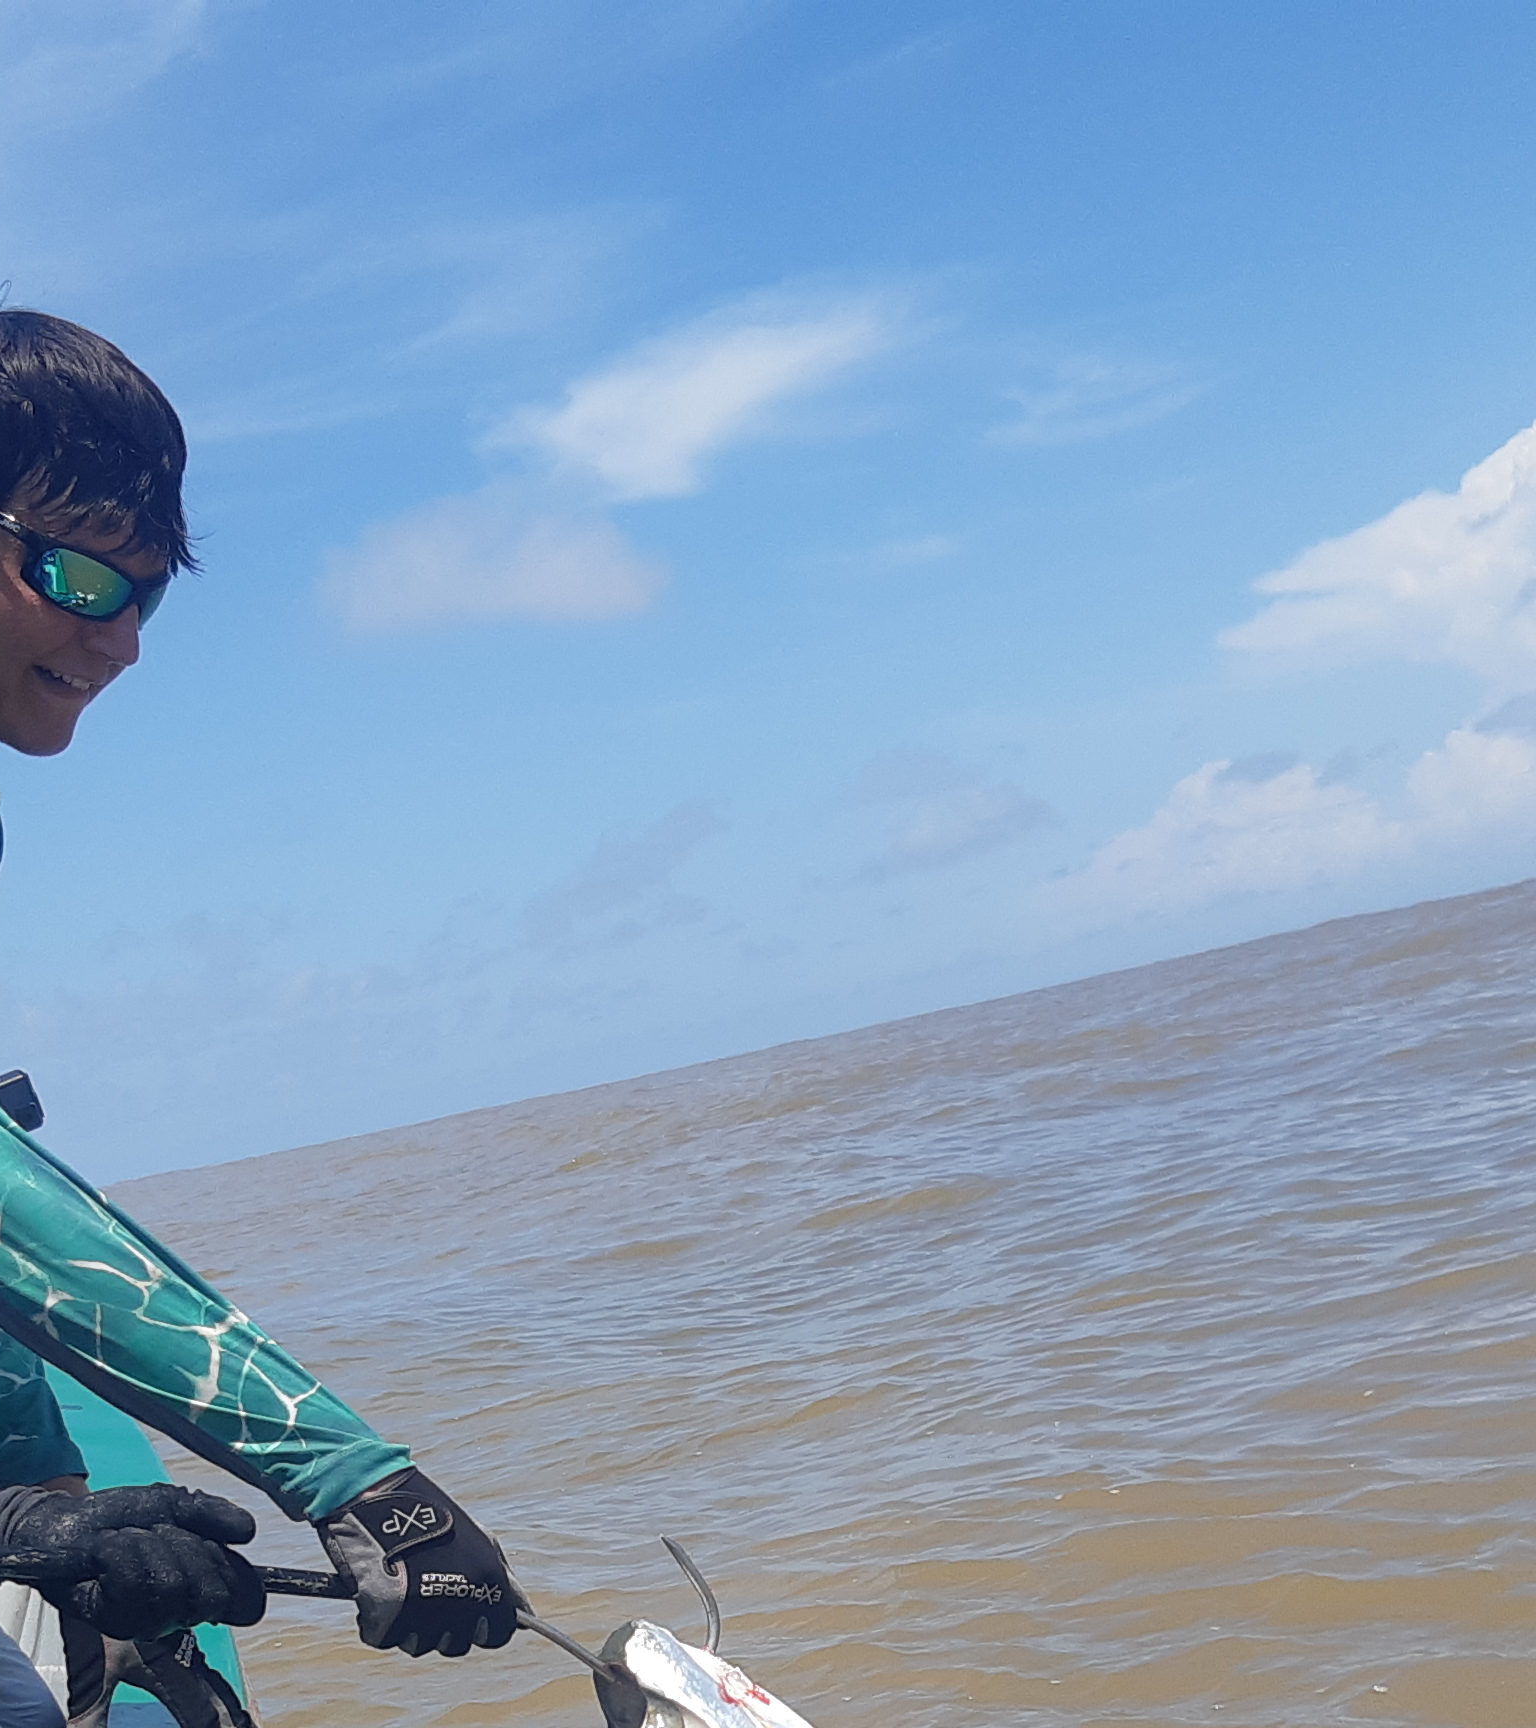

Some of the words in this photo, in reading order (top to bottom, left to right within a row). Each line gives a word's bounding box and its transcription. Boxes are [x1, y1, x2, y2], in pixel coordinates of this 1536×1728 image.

[382, 1503, 437, 1537] EXP
[421, 1573, 468, 1584] TACKLES
[420, 1582, 503, 1606] EXPLORER
